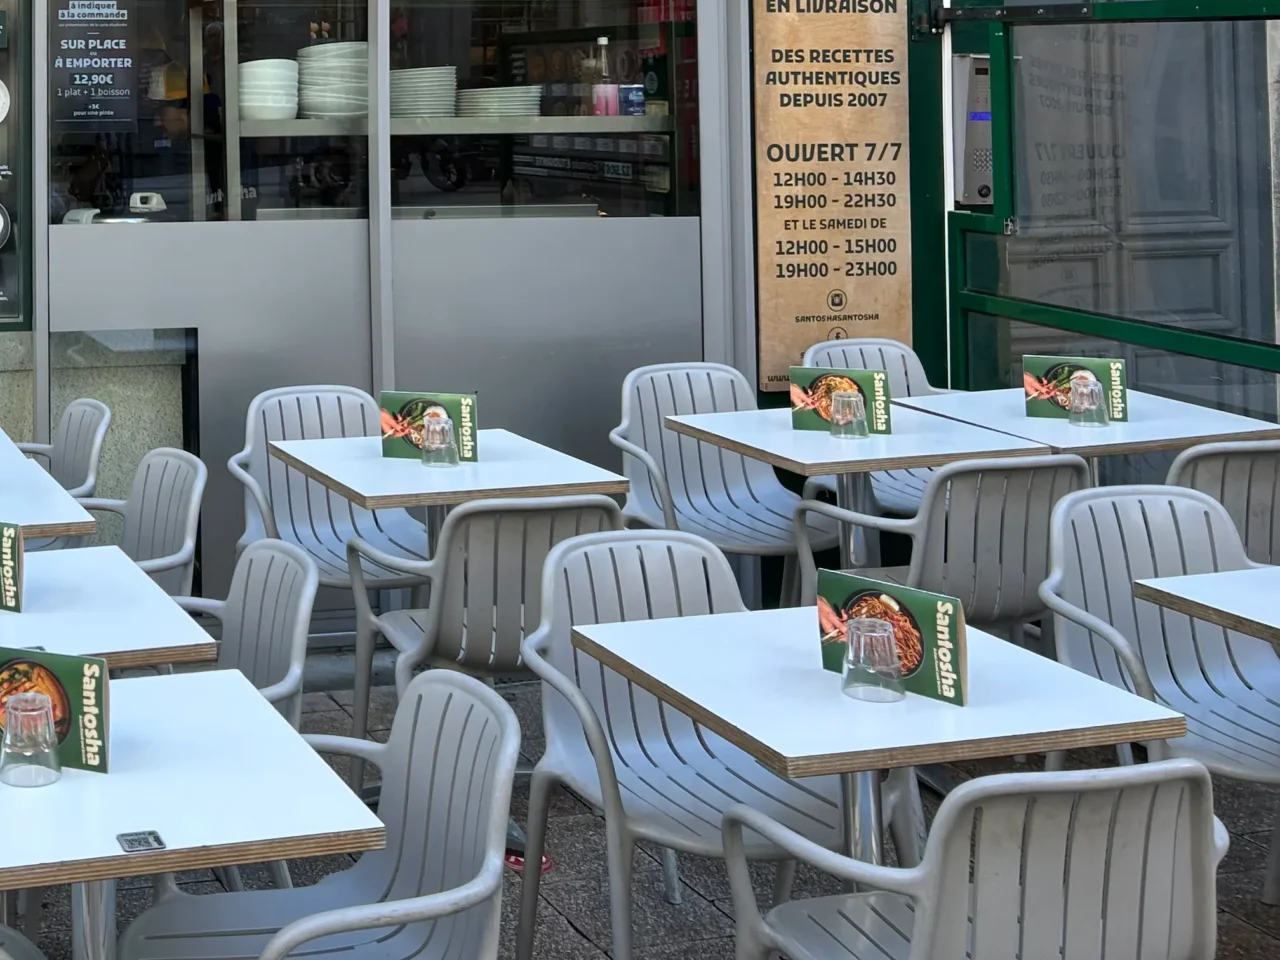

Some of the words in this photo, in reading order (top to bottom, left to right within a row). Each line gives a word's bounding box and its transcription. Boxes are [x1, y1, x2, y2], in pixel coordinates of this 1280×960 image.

[78, 2, 115, 10] indiquer
[61, 39, 86, 49] SUR
[89, 39, 126, 49] PLACE
[55, 56, 63, 67] À
[66, 58, 132, 67] EMPORTER
[772, 49, 805, 63] DES
[810, 49, 894, 63] RECETTES
[74, 74, 113, 86] 12,90€
[765, 71, 900, 87] AUTHENTIQUES
[65, 88, 81, 98] plat
[98, 88, 130, 96] boisson
[780, 93, 843, 107] DEPUIS
[847, 93, 888, 107] 2007
[766, 143, 859, 162] OUVERT
[865, 142, 903, 162] 7/7
[773, 172, 826, 187] 12H00
[843, 171, 896, 186] 14H30
[773, 194, 827, 209] 19H00
[843, 193, 896, 208] 22H30
[784, 219, 799, 230] ET
[802, 219, 817, 230] LE
[819, 218, 867, 230] SAMEDI
[871, 218, 887, 229] DE
[775, 240, 828, 255] 12H00
[844, 238, 897, 254] 15H00
[775, 263, 828, 278] 19H00
[845, 261, 897, 277] 23H00
[795, 312, 879, 323] SANTOSHASANTOSHA
[1109, 362, 1123, 420] Santosha
[874, 373, 888, 431] Santosha
[461, 397, 475, 458] Santosha
[0, 526, 18, 607] Santosha
[936, 601, 957, 699] Santosha
[82, 663, 102, 766] Santosha
